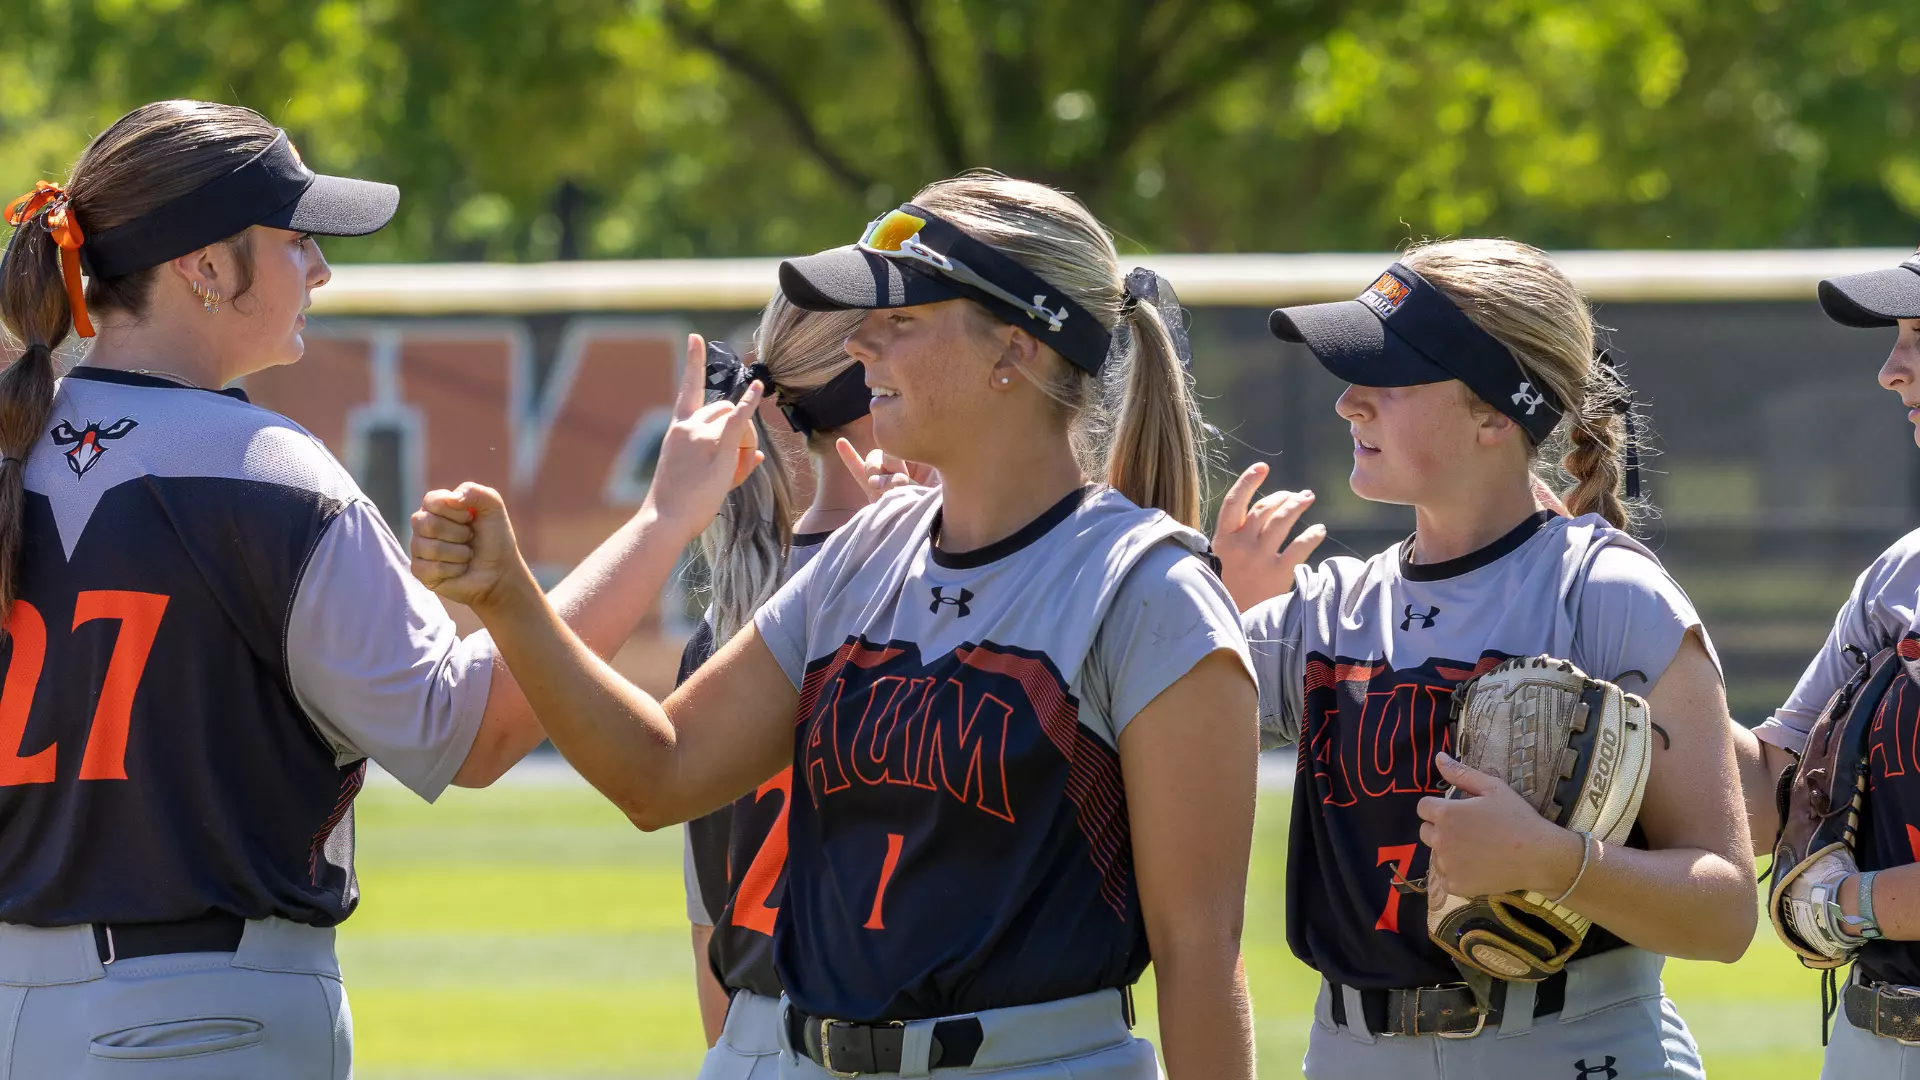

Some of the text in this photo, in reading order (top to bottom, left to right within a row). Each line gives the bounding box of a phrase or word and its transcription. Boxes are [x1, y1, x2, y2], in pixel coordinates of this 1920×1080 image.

[1371, 273, 1410, 307] UM
[0, 589, 171, 786] 27
[806, 676, 1015, 823] AUM
[1588, 727, 1617, 810] A2000
[862, 833, 904, 930] 1
[1374, 843, 1418, 933] 7
[1477, 947, 1524, 975] Wilson
